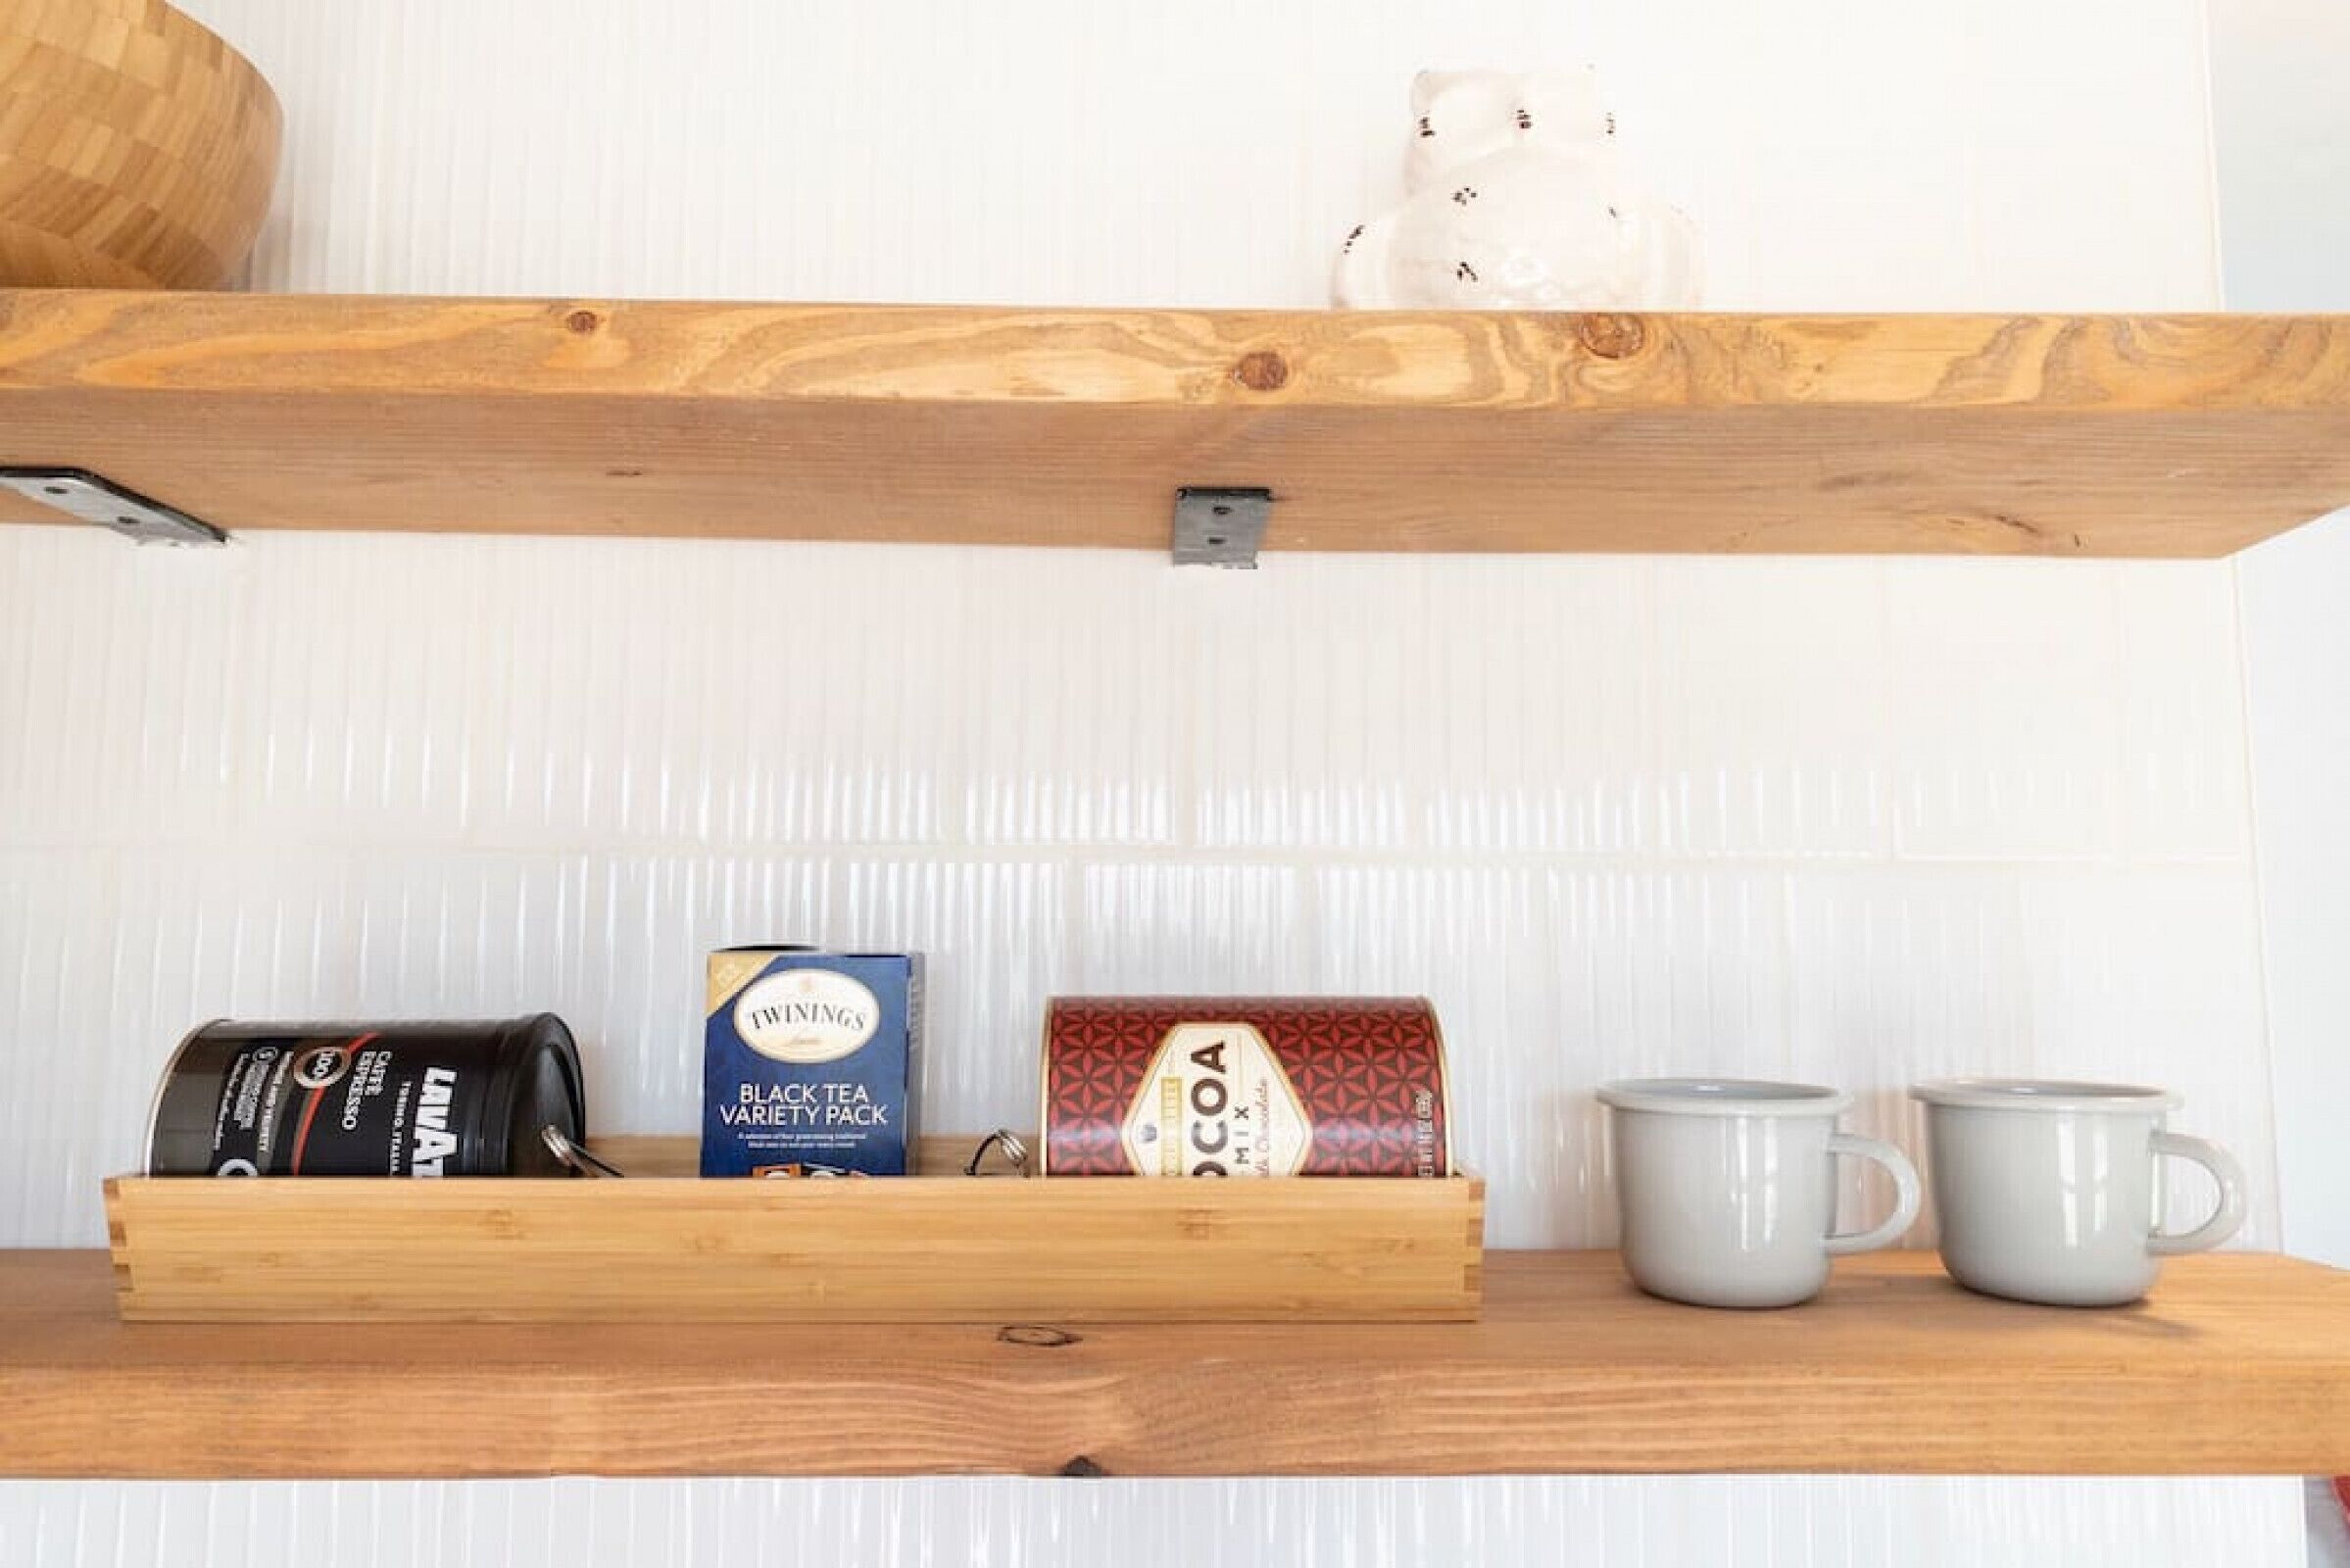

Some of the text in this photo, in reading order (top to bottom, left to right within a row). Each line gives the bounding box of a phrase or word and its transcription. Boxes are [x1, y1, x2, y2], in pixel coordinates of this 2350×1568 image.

[751, 1003, 864, 1030] TWININGS
[342, 1052, 376, 1131] ESPRESSO
[740, 1083, 868, 1103] BLACK TEA
[720, 1104, 888, 1126] VARIETY PACK
[1233, 1105, 1249, 1165] MIX
